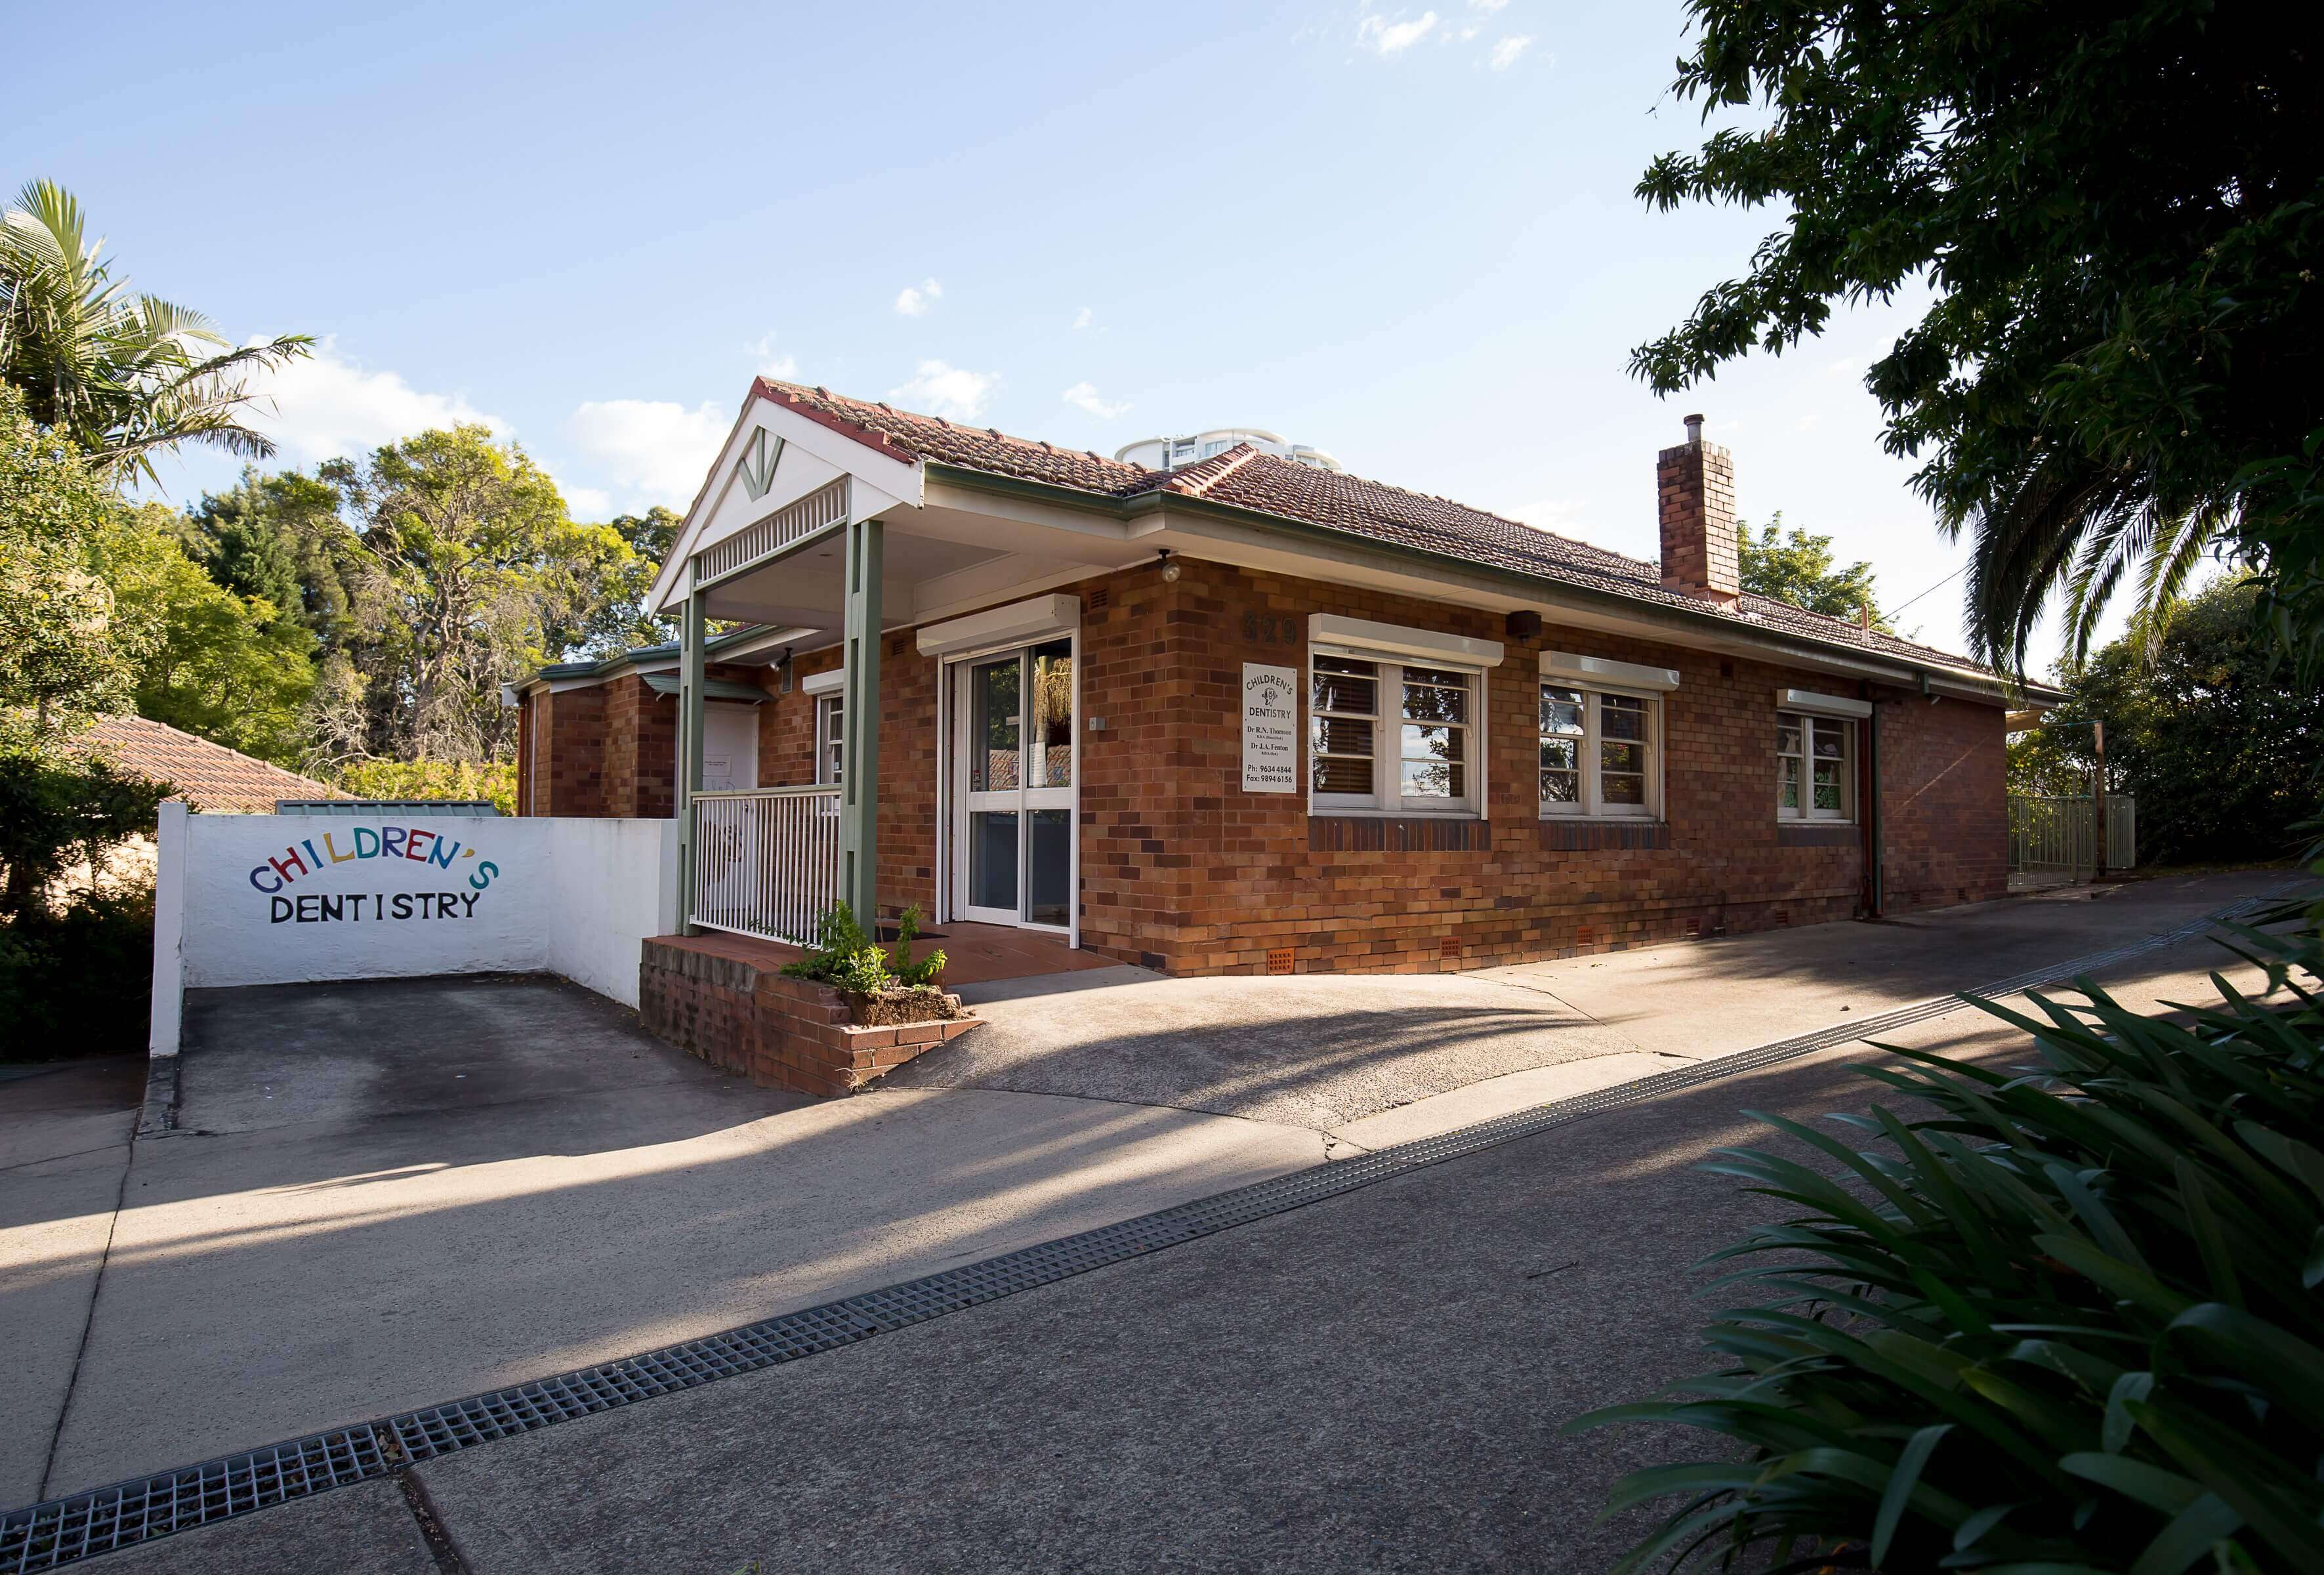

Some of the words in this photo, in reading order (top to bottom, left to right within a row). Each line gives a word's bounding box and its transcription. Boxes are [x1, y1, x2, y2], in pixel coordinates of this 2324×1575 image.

[1247, 675, 1293, 694] CHILDREN'S
[1249, 707, 1291, 719] DENTISTRY
[249, 826, 499, 894] CHILDREN'S
[270, 892, 480, 924] DENTISTRY
